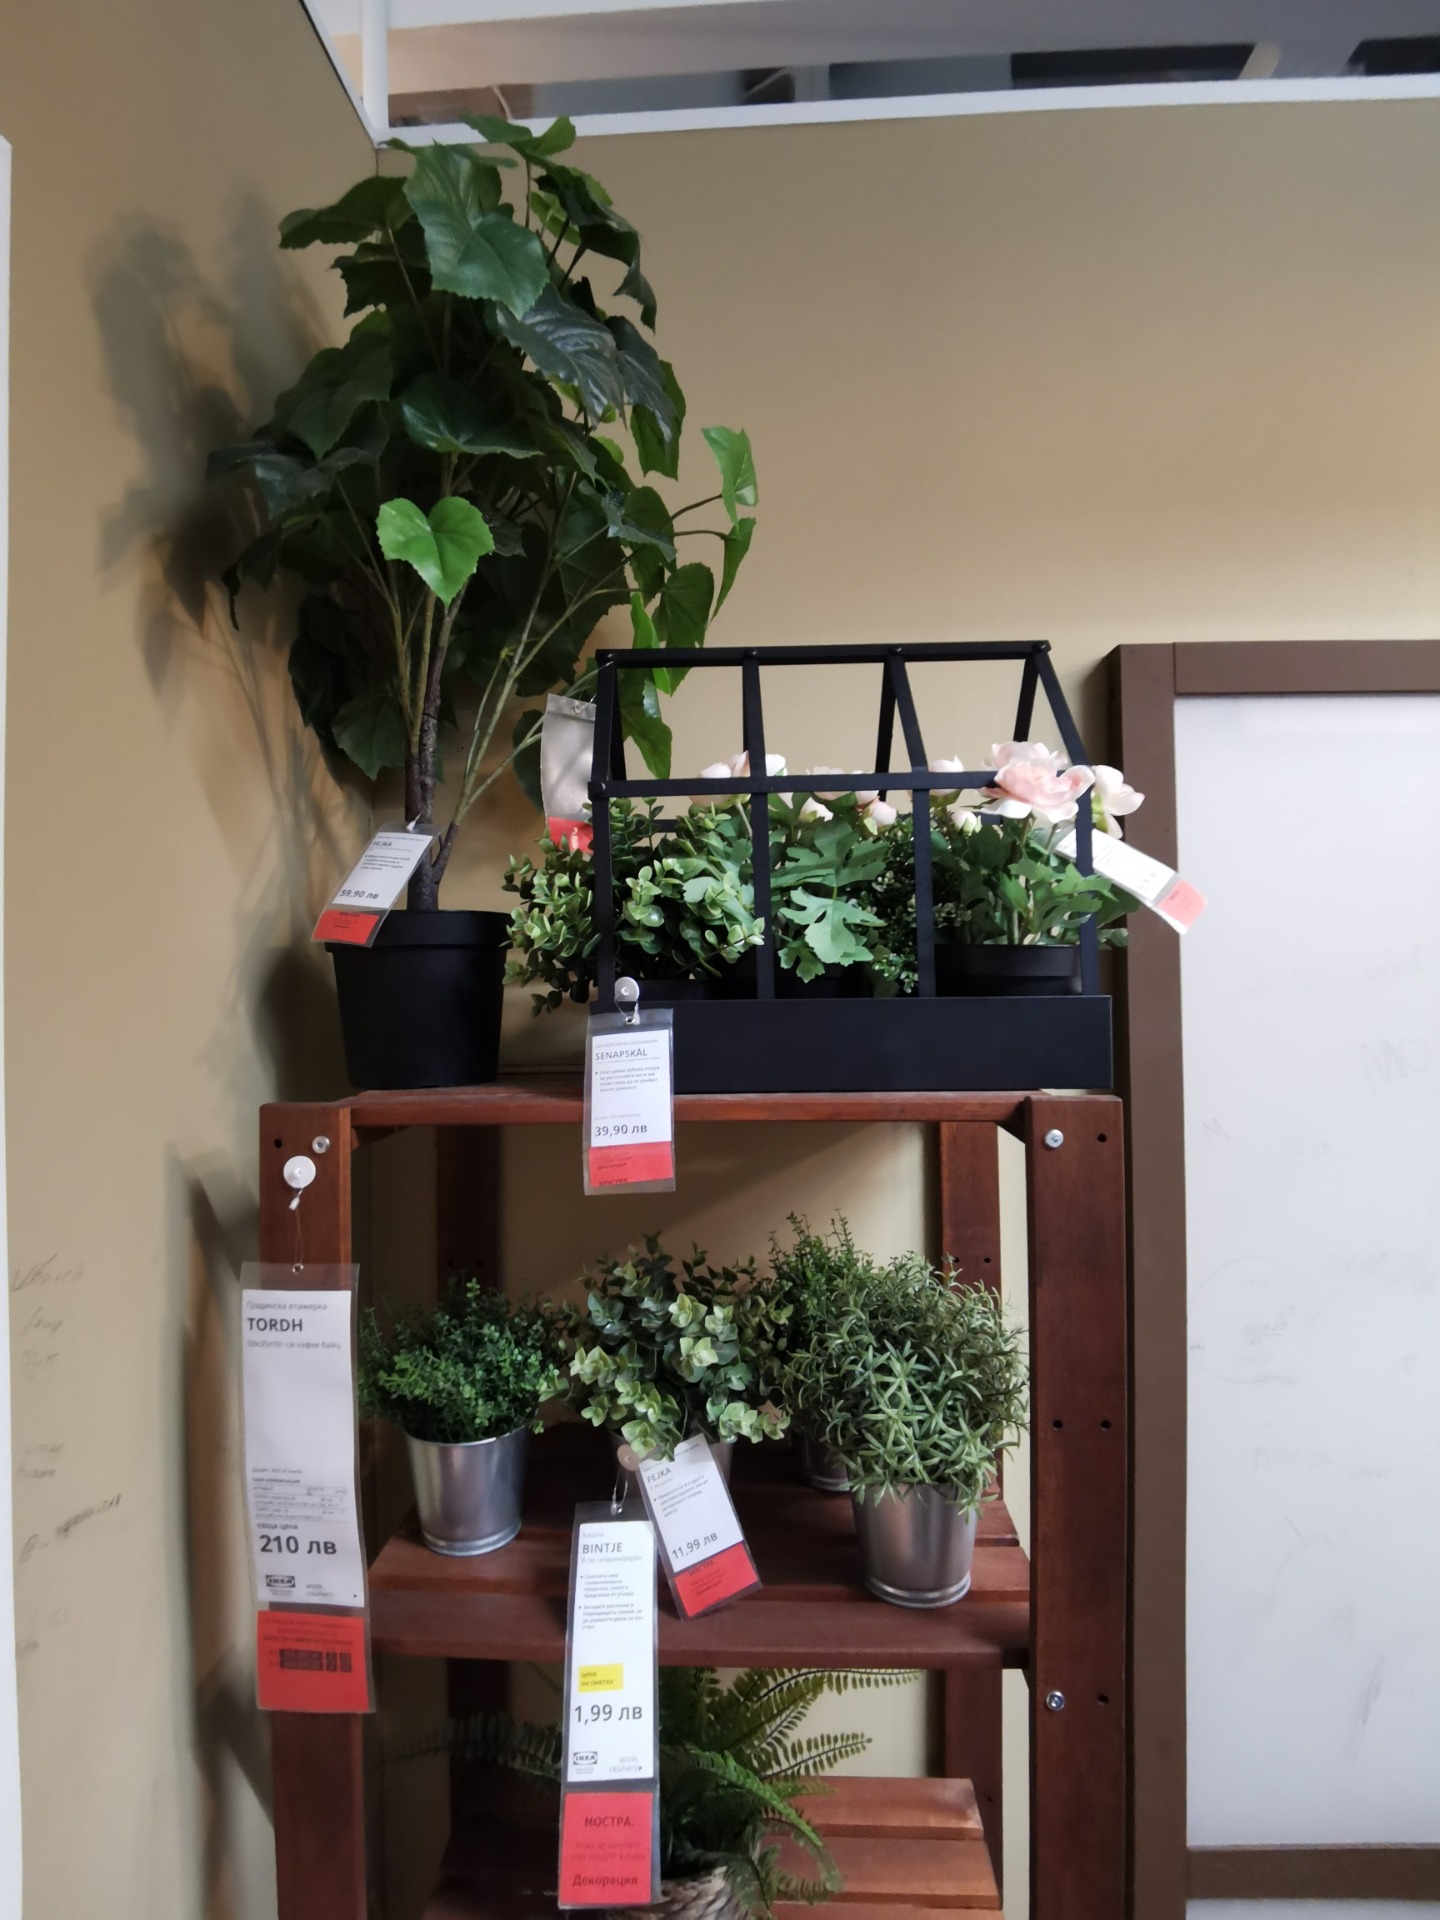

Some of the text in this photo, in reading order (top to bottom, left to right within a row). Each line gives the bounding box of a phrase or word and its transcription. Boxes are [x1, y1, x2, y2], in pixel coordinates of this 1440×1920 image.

[594, 1123, 649, 1138] 39,90 лв
[246, 1317, 303, 1332] TORDH
[646, 1467, 672, 1484] FEJKA
[258, 1534, 338, 1555] 210 лв
[582, 1542, 623, 1554] BINTJE
[672, 1532, 718, 1559] 11,99 лв
[267, 1577, 295, 1586] IKEA
[574, 1703, 643, 1725] 1,99 лв
[572, 1873, 639, 1888] Декорация
